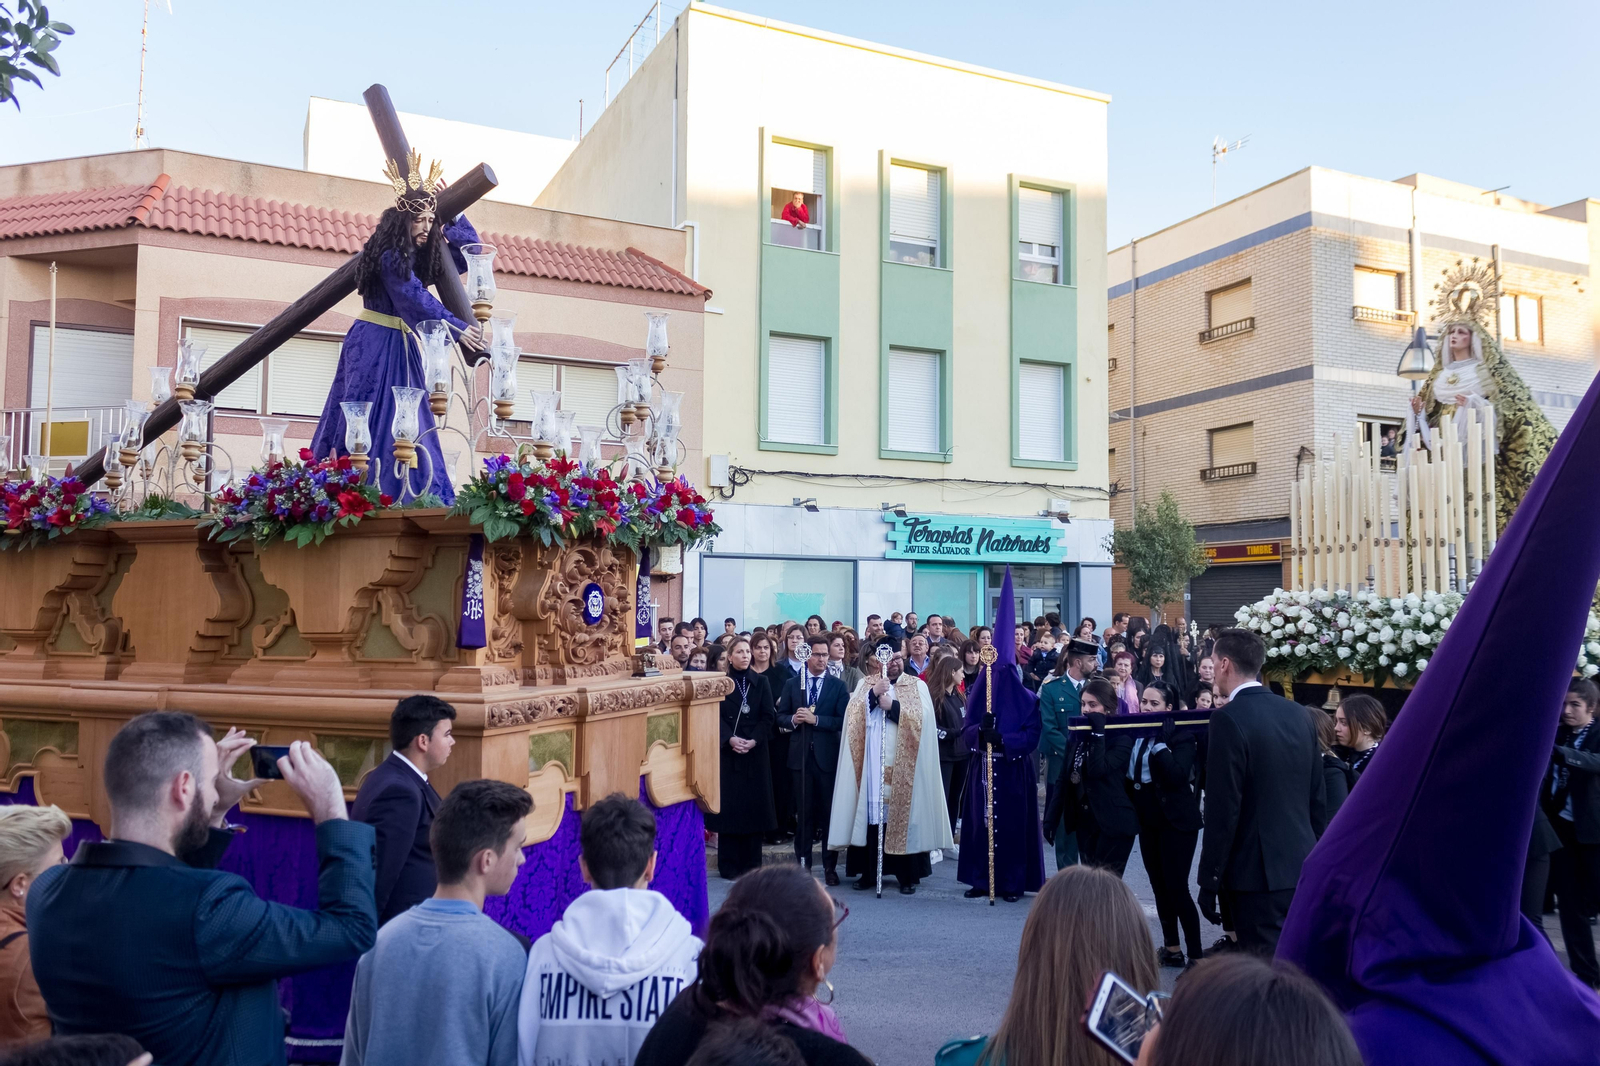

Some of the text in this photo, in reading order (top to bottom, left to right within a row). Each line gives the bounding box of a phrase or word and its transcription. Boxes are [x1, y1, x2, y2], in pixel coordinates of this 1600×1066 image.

[903, 517, 1051, 555] Terapias Naturales
[903, 545, 971, 555] JAVIER SALVADOR
[1246, 544, 1273, 556] TIMBRE
